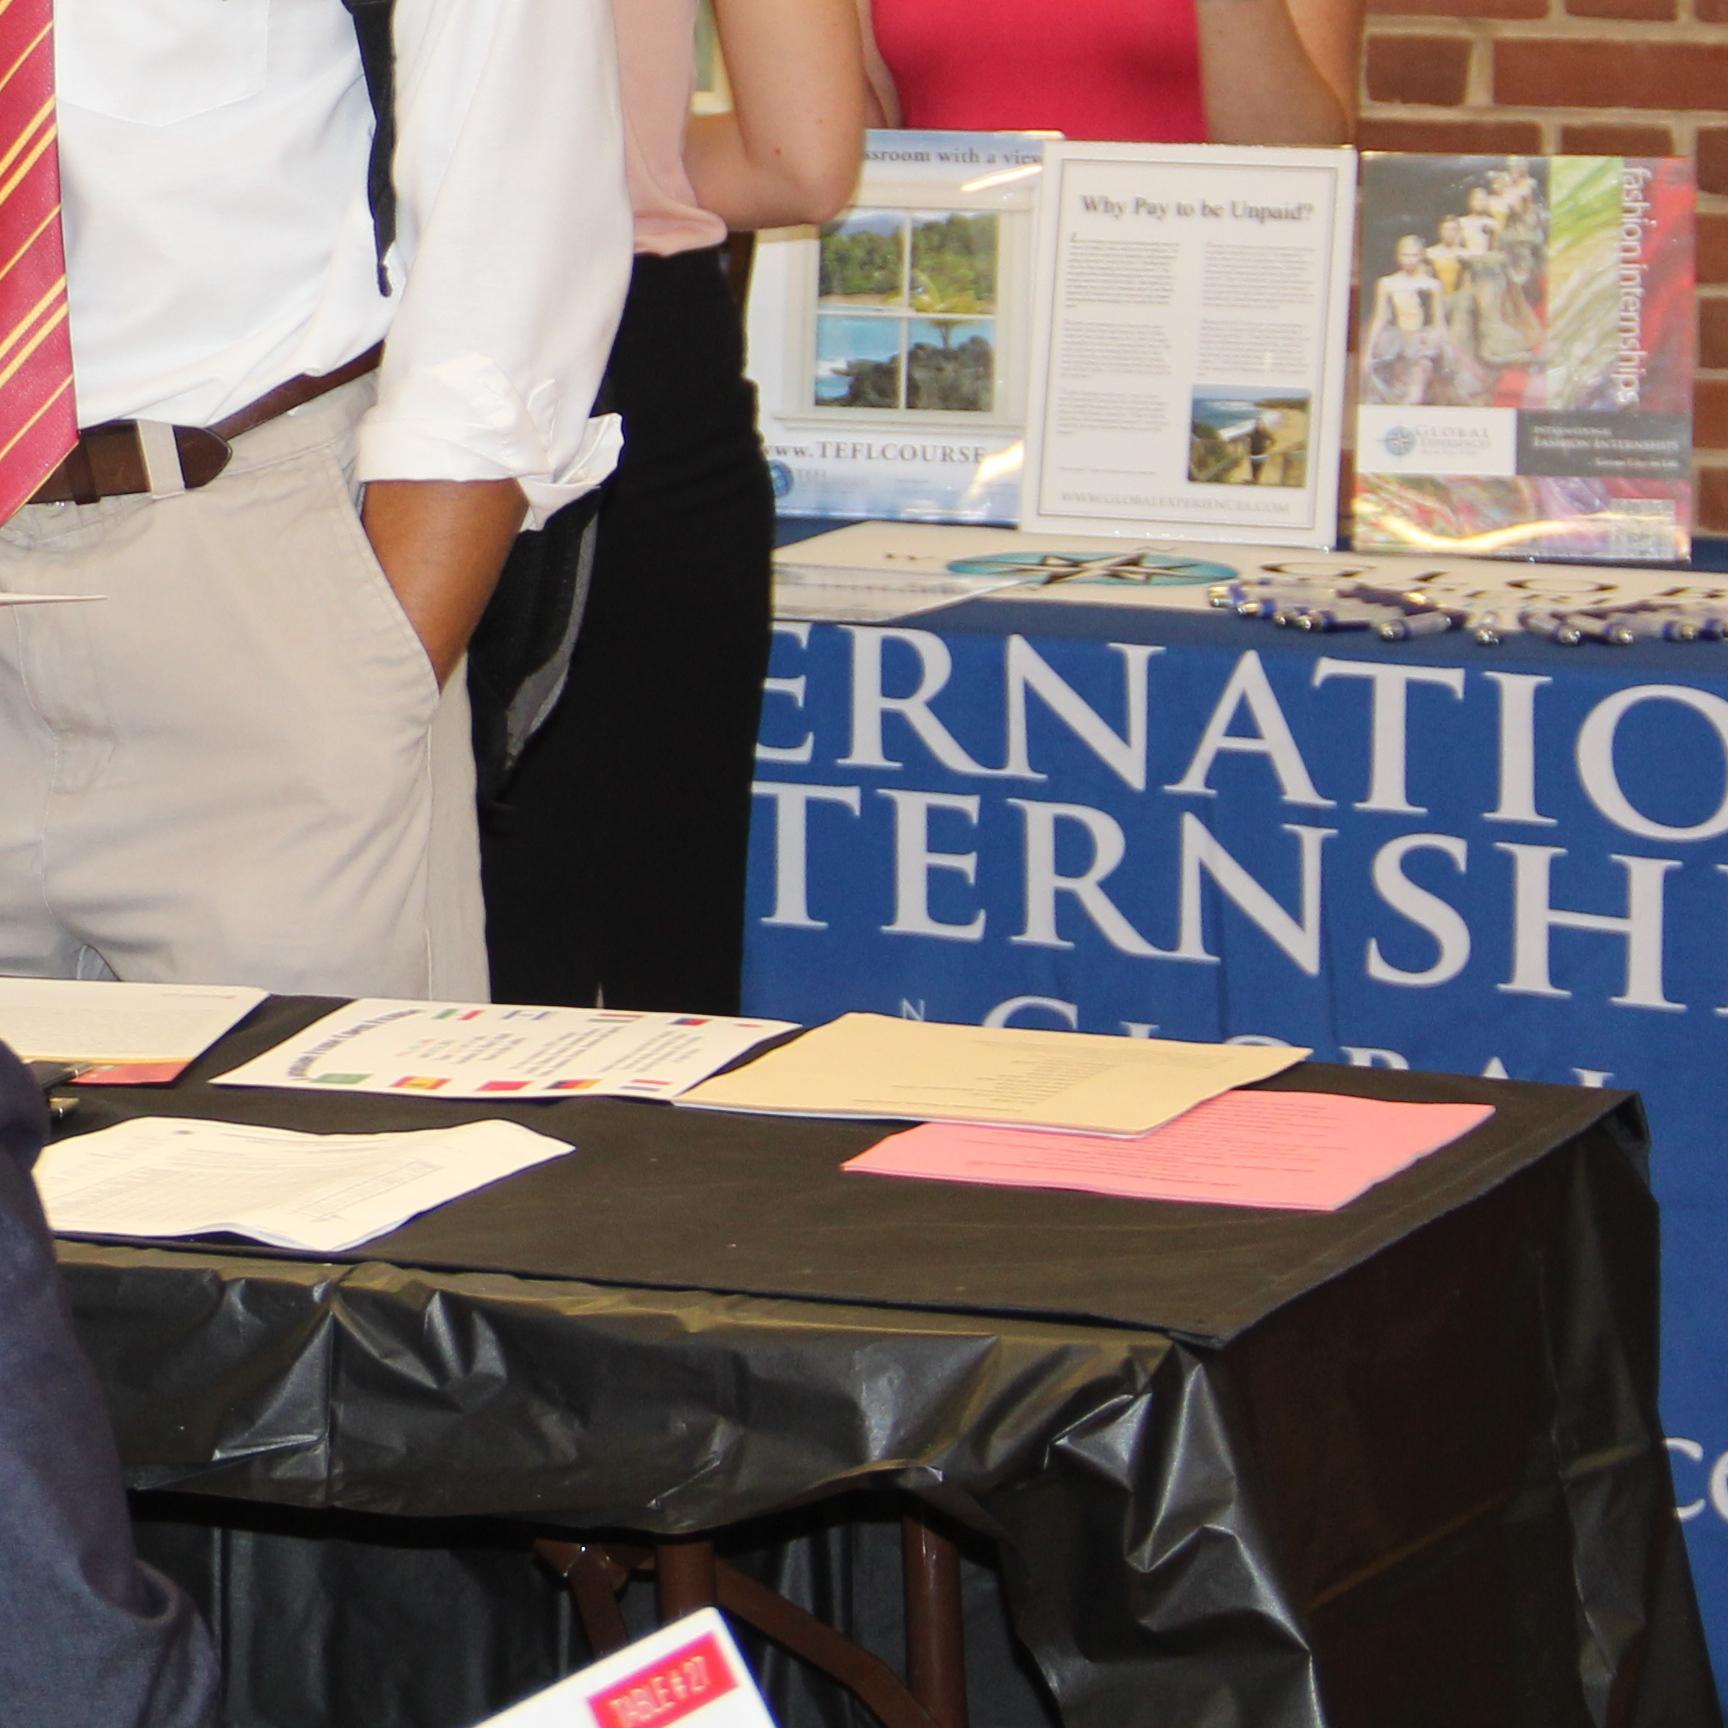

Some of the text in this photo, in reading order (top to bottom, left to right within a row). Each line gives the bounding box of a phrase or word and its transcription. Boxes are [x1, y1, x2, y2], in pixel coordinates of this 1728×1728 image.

[938, 147, 980, 165] with
[986, 152, 997, 165] a
[1080, 194, 1314, 224] Why Pay to be Unpaid?
[750, 781, 1728, 1015] TERNSH
